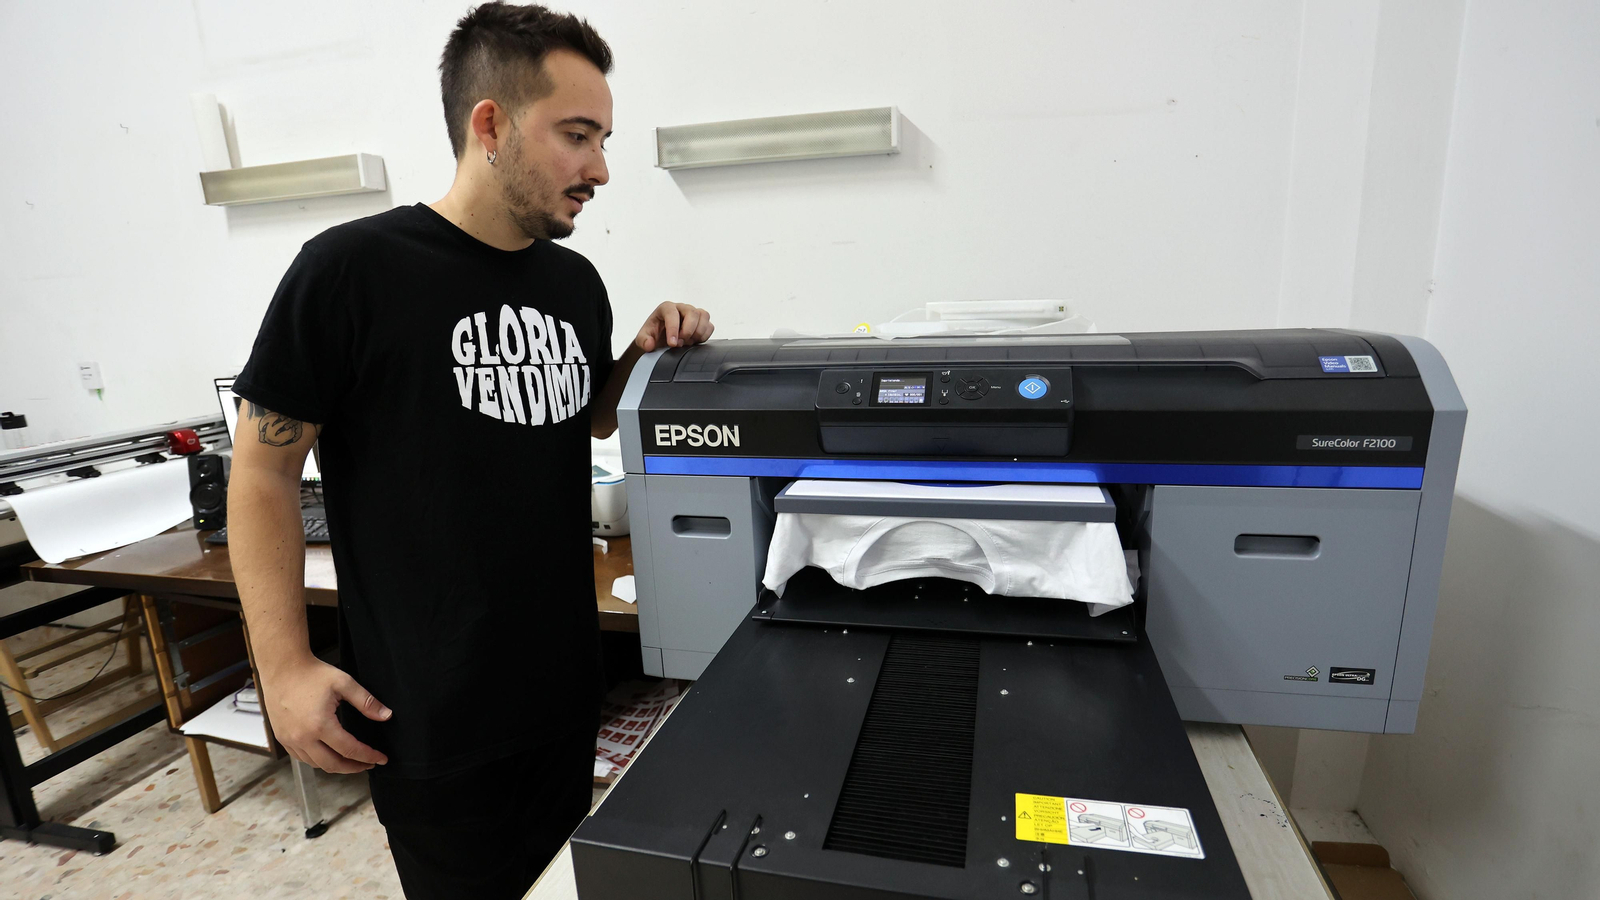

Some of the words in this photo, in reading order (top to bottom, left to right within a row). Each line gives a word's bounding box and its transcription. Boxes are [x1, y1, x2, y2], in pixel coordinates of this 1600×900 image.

[452, 304, 587, 365] GLORIA
[453, 364, 591, 426] VENDIMIA
[655, 424, 740, 447] EPSON
[1312, 438, 1360, 448] SureColor
[1363, 439, 1396, 448] F2100
